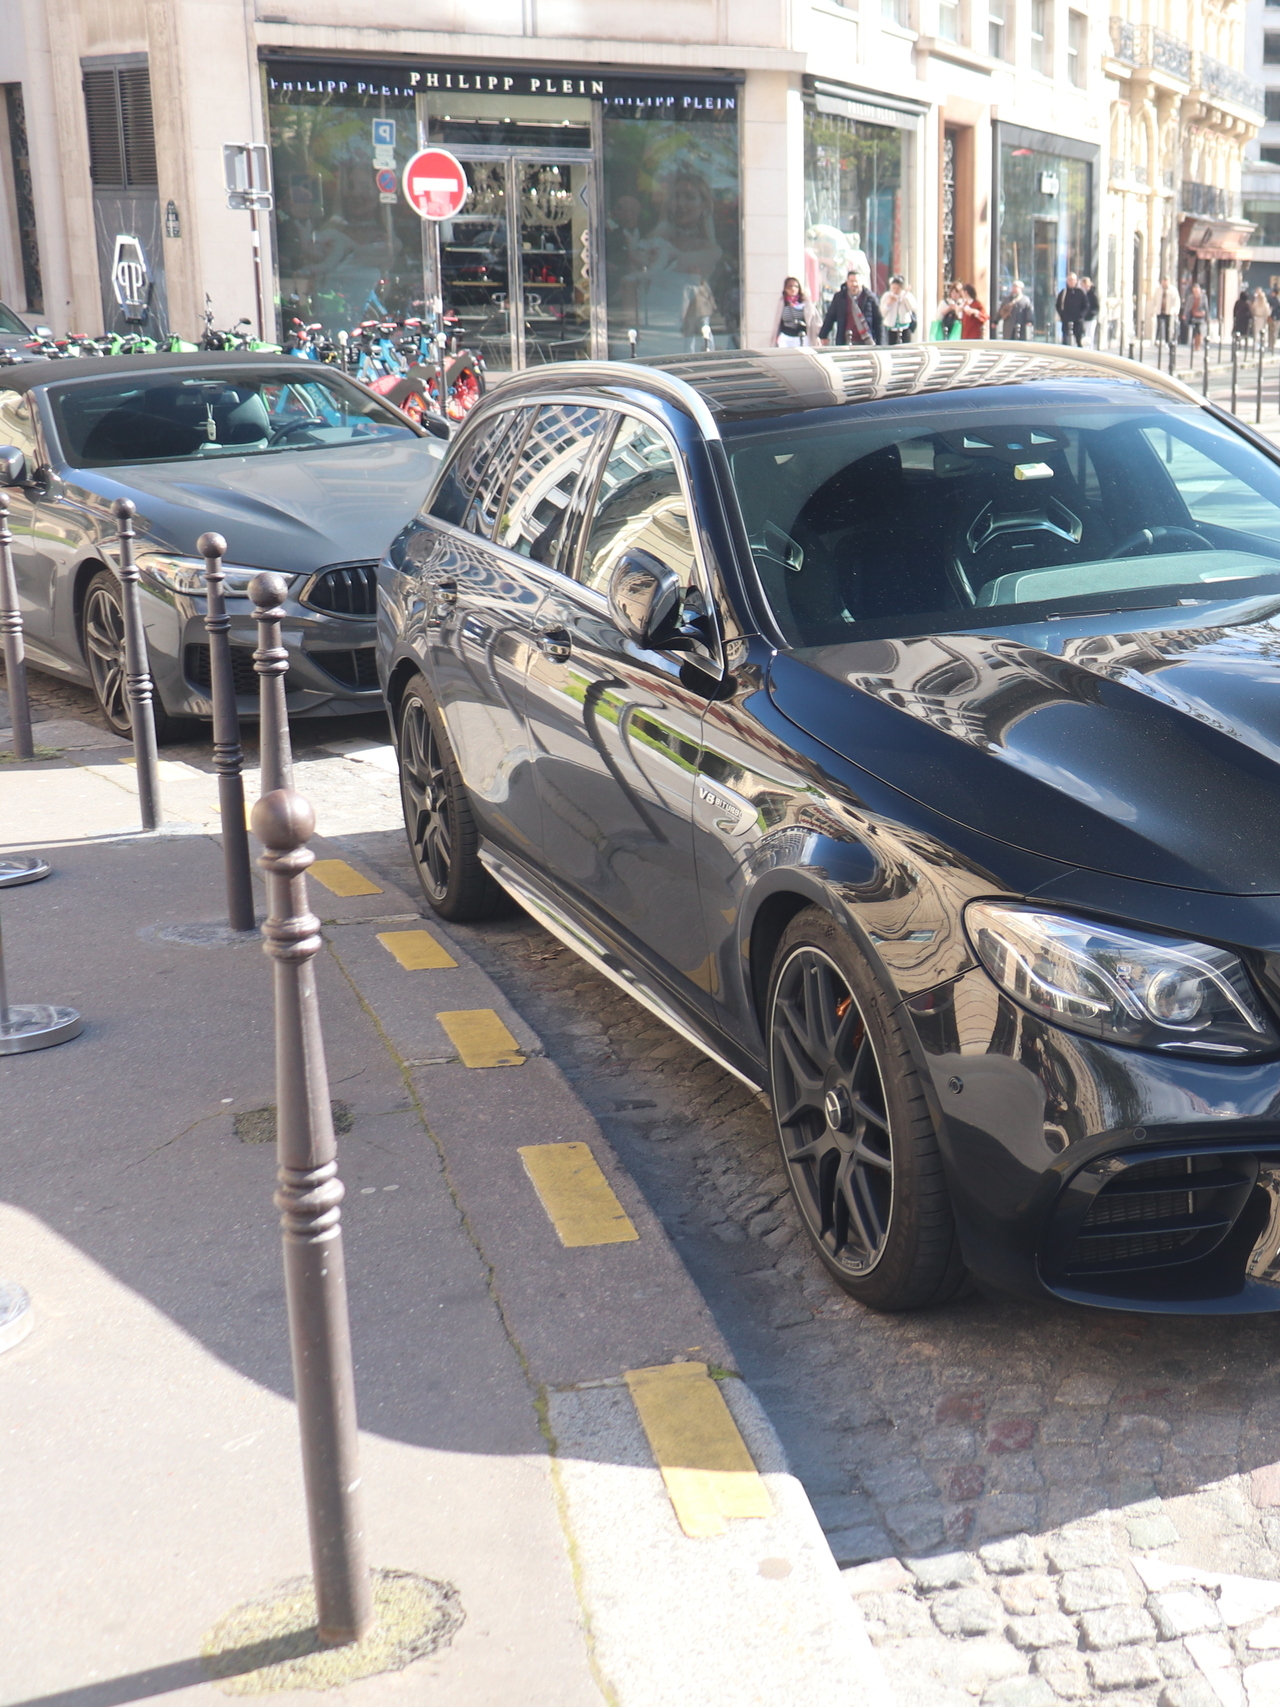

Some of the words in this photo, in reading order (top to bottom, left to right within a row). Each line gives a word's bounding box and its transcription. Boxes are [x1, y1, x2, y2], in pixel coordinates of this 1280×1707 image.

[270, 78, 348, 93] PHILIPP
[358, 82, 414, 96] PLEIN
[410, 72, 514, 91] PHILIPP
[530, 78, 604, 95] PLEIN
[683, 96, 735, 110] PLEIN
[700, 787, 716, 805] V8
